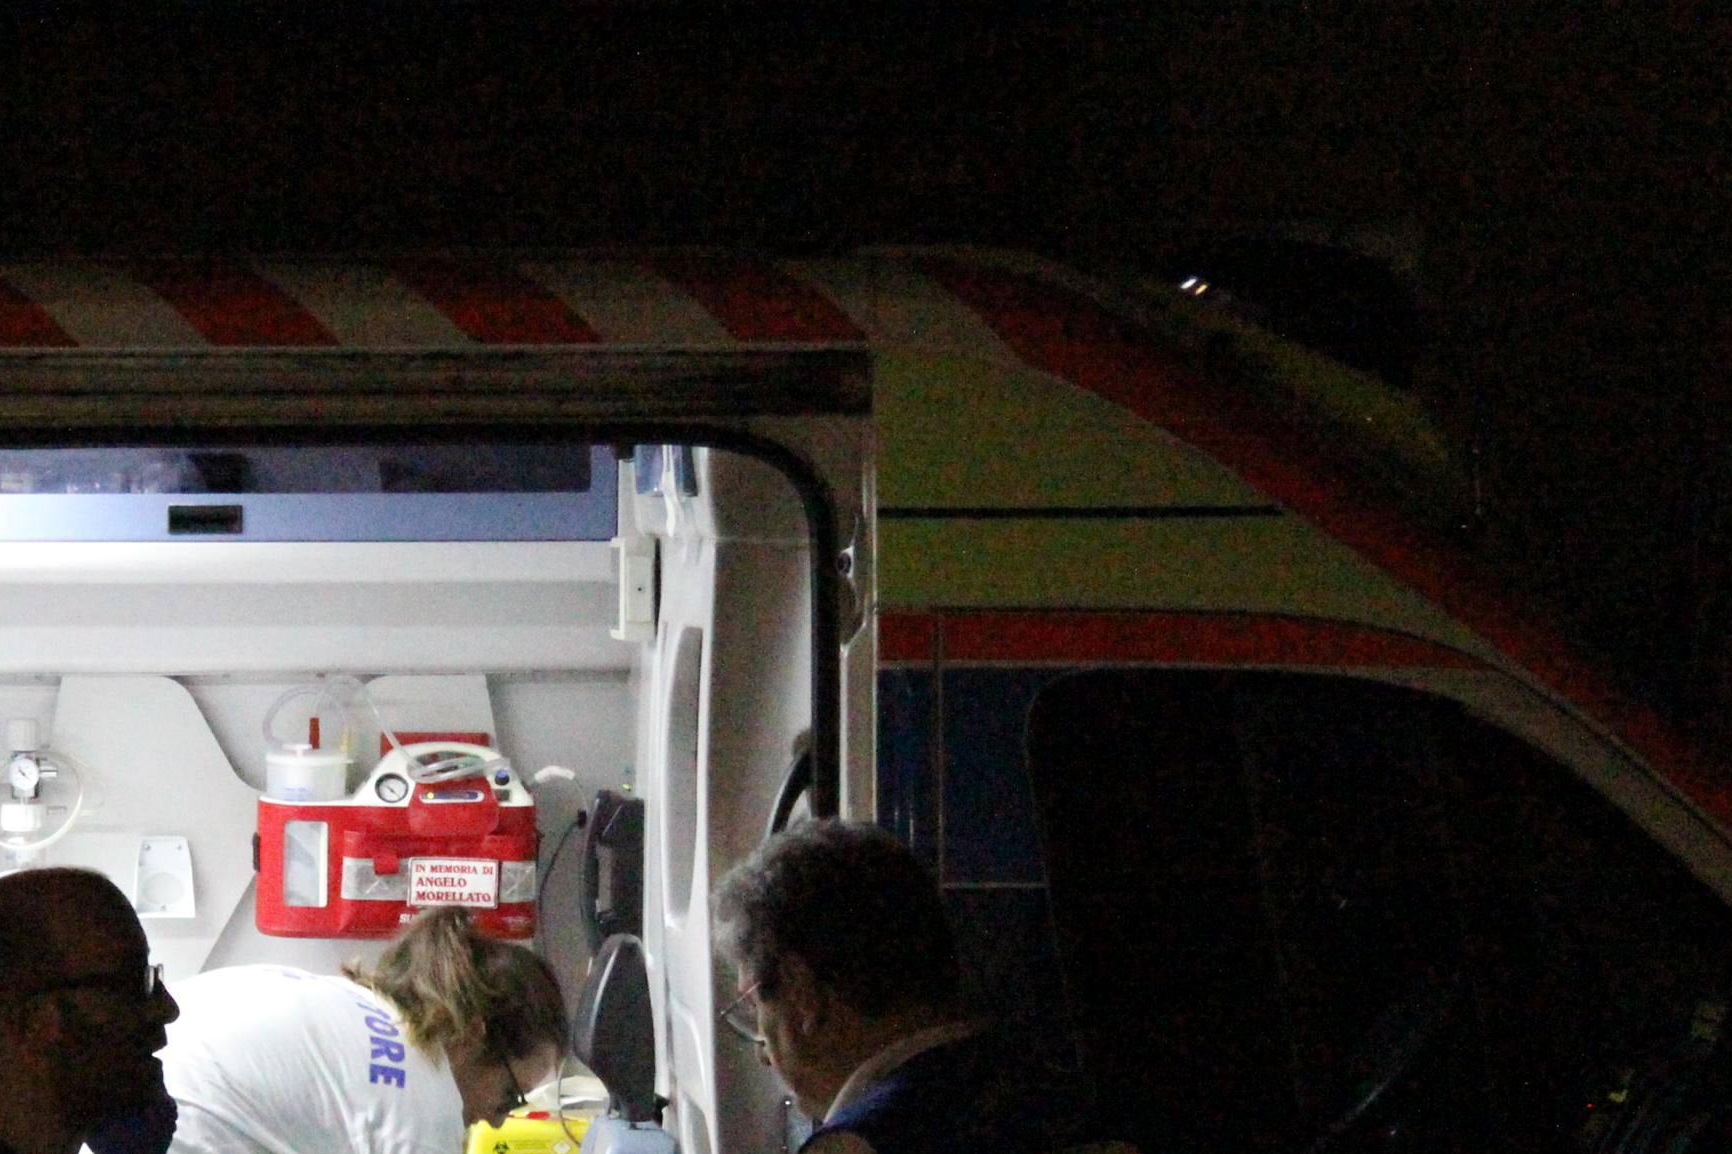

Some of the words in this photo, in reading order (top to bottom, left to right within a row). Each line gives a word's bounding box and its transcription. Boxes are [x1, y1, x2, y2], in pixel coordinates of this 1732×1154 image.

[415, 863, 426, 873] IN
[430, 865, 478, 875] MEMORIA
[482, 866, 493, 876] DI
[416, 876, 467, 888] ANGELO
[415, 890, 492, 903] MORELLATO
